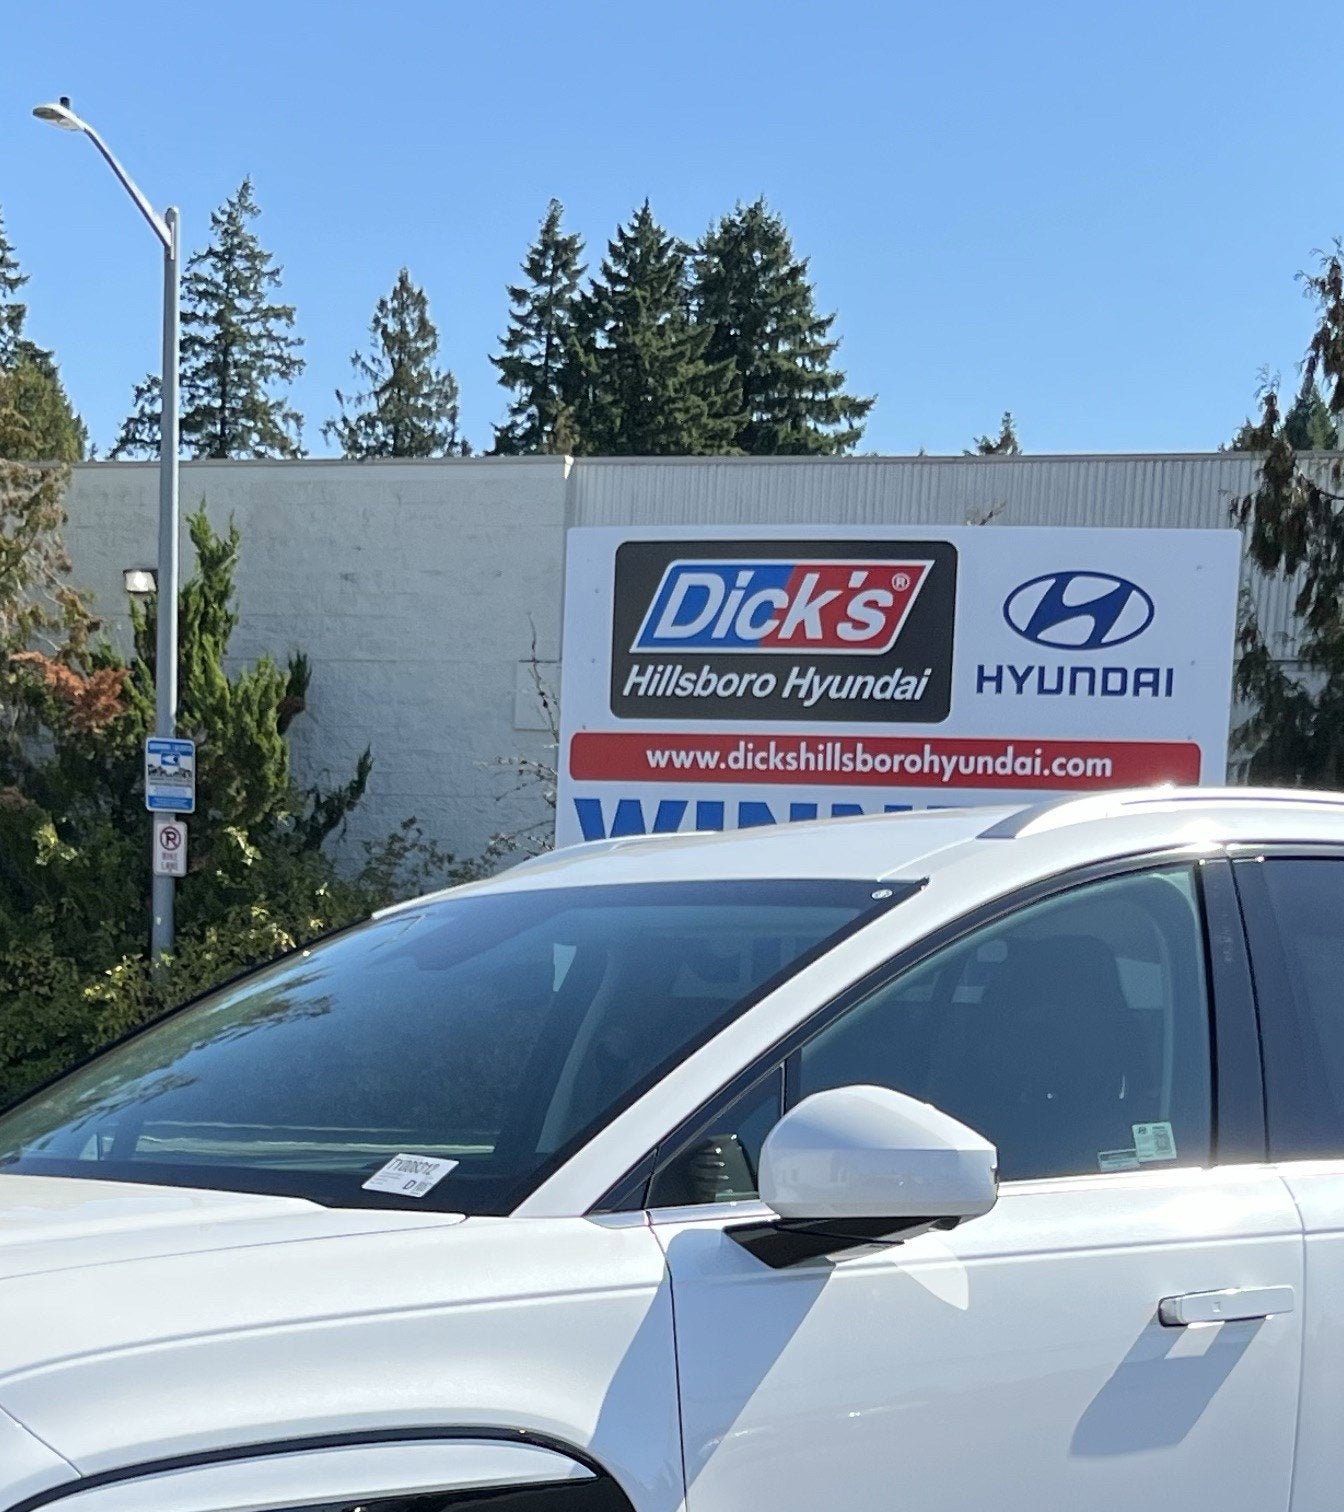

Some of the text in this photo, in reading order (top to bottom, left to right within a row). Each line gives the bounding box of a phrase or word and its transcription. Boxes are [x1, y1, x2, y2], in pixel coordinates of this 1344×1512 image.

[623, 665, 932, 707] Hillsboro Hyundai
[977, 665, 1174, 697] HYUNDAI
[646, 741, 1113, 782] www.dickshillsborohyundai.com
